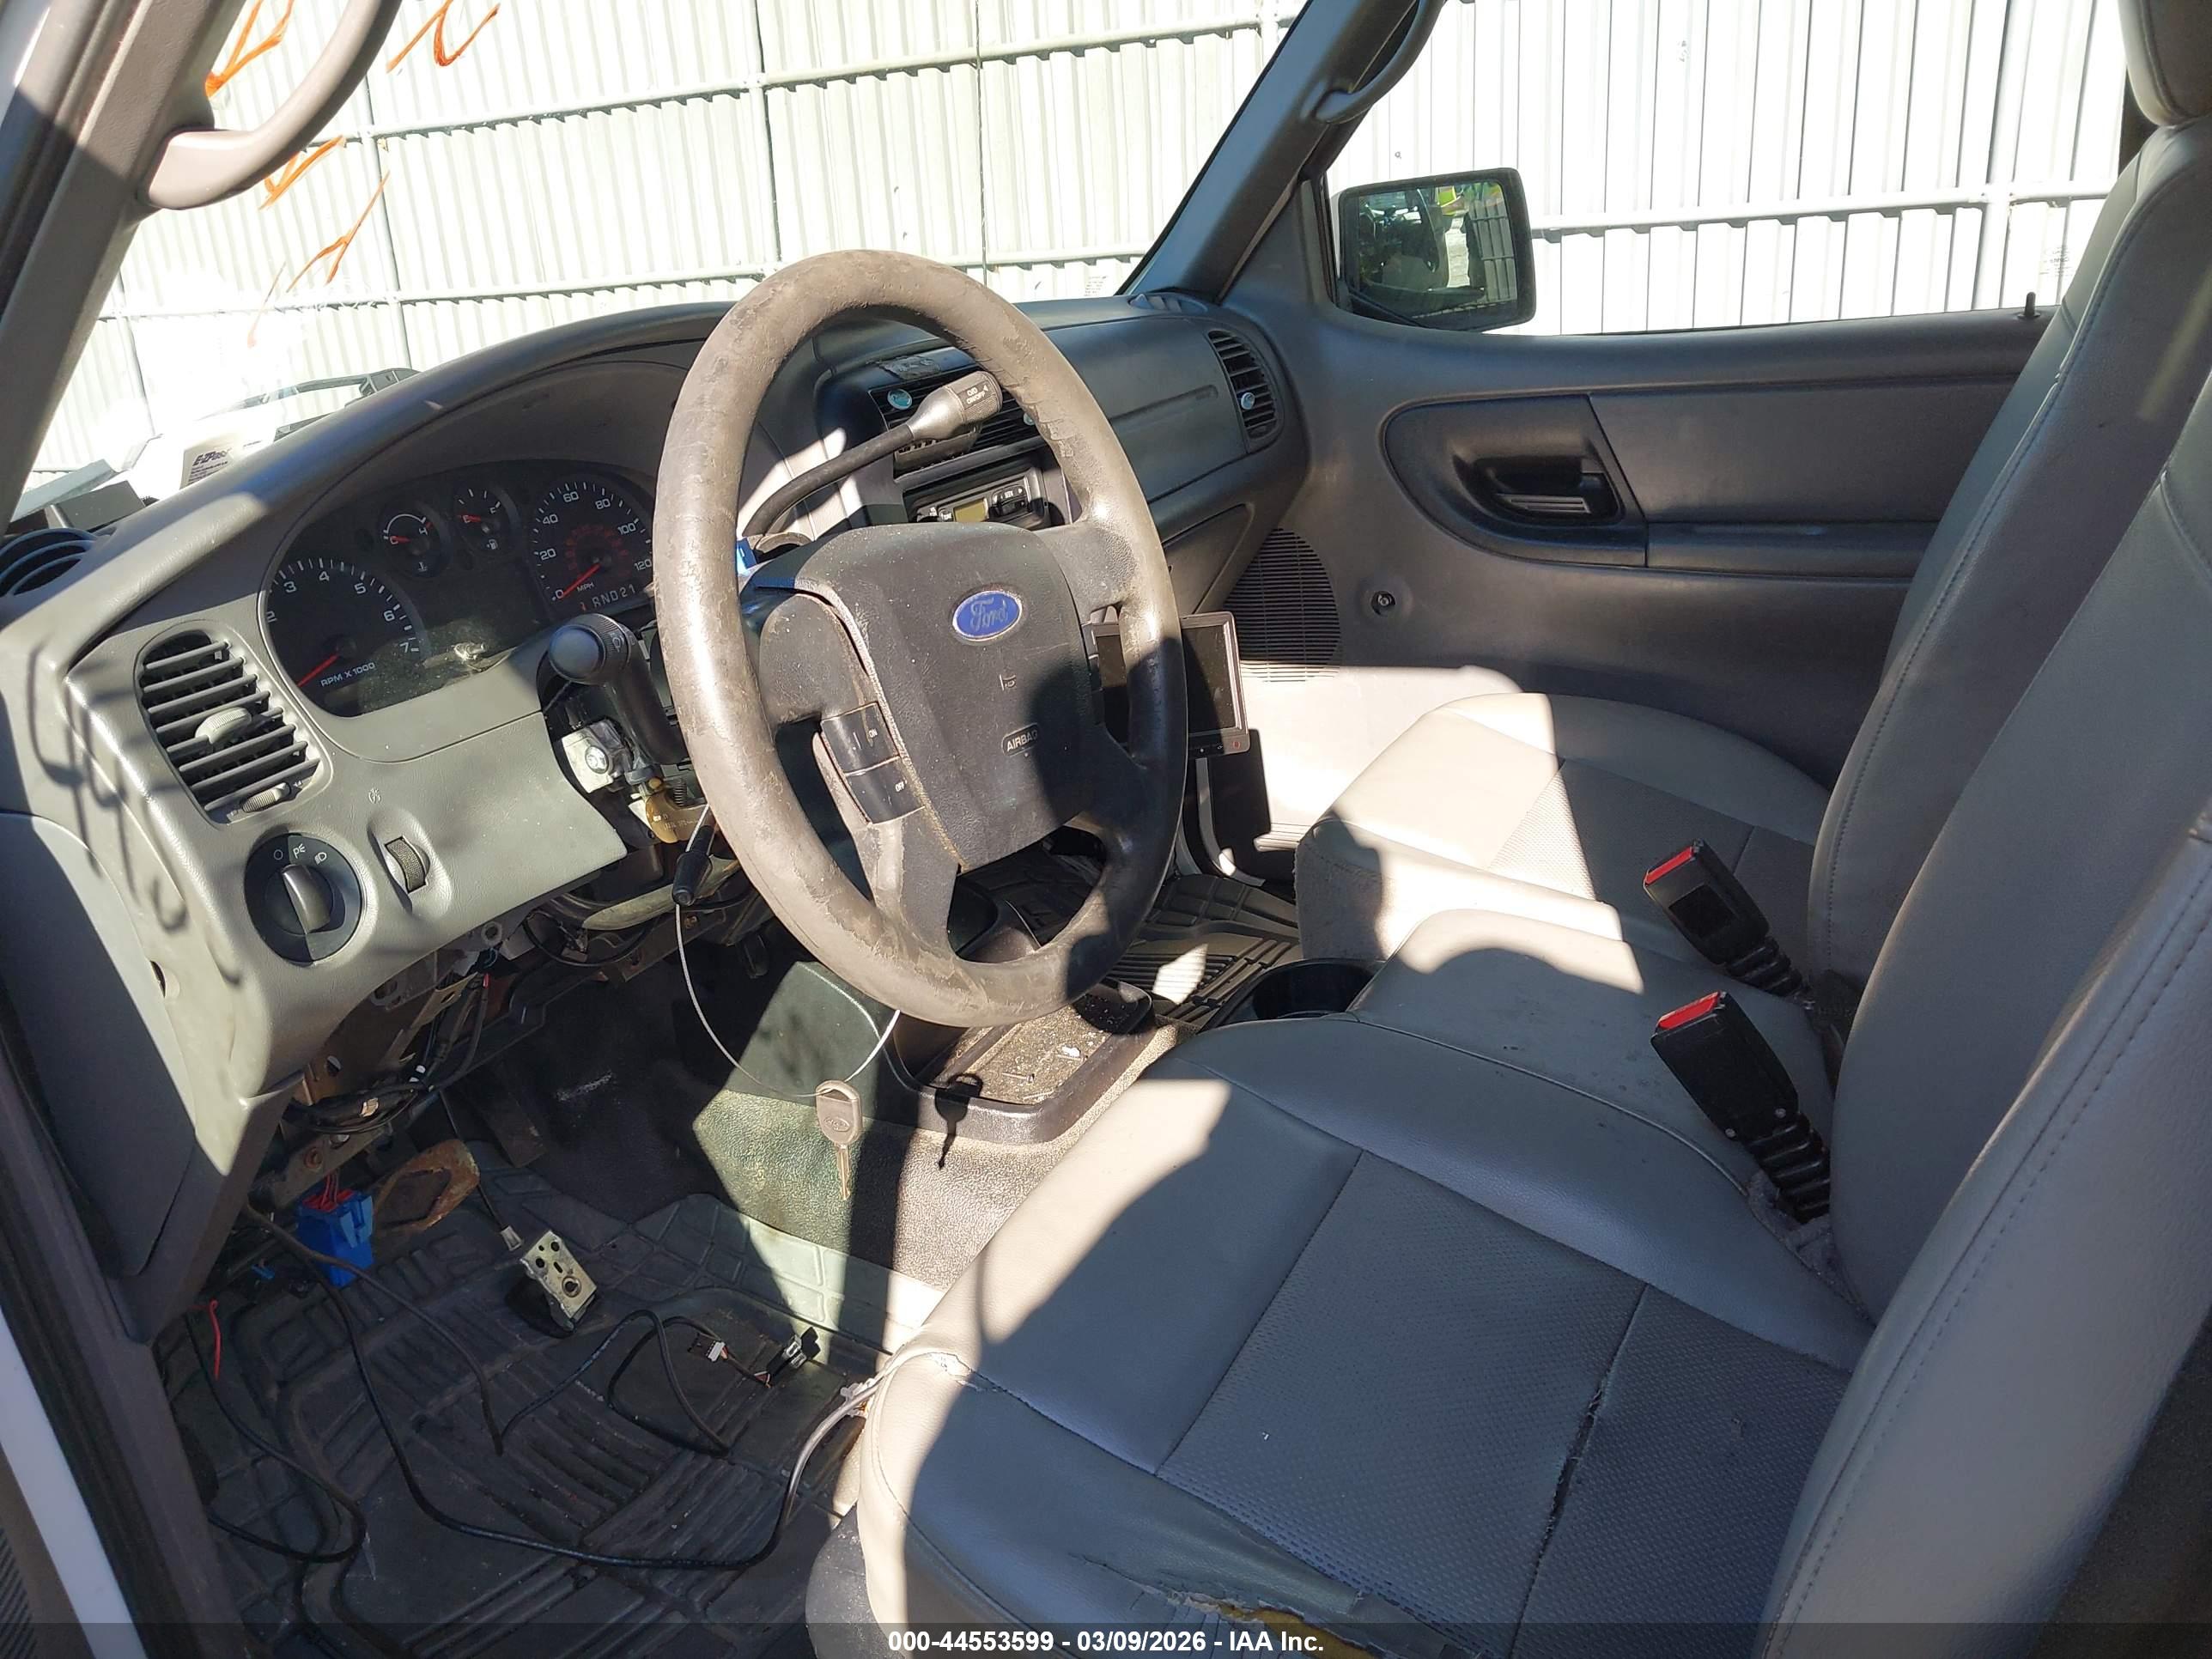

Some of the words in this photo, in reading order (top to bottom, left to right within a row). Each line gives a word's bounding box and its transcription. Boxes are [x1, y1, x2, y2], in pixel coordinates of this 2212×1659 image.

[562, 490, 580, 503] 60
[594, 498, 611, 510] 80
[542, 514, 558, 525] 40
[617, 522, 637, 536] 100
[539, 548, 557, 561] 20
[634, 558, 653, 571] 120
[319, 570, 330, 582] 4
[283, 580, 297, 593] 3
[354, 582, 367, 594] 5
[576, 581, 595, 592] MPH
[383, 610, 395, 622] 6
[969, 597, 1008, 632] Ford
[399, 641, 410, 653] 7
[320, 673, 343, 687] RPM
[353, 661, 376, 676] 1000
[868, 728, 878, 738] ON
[1006, 729, 1037, 752] AIRBAG
